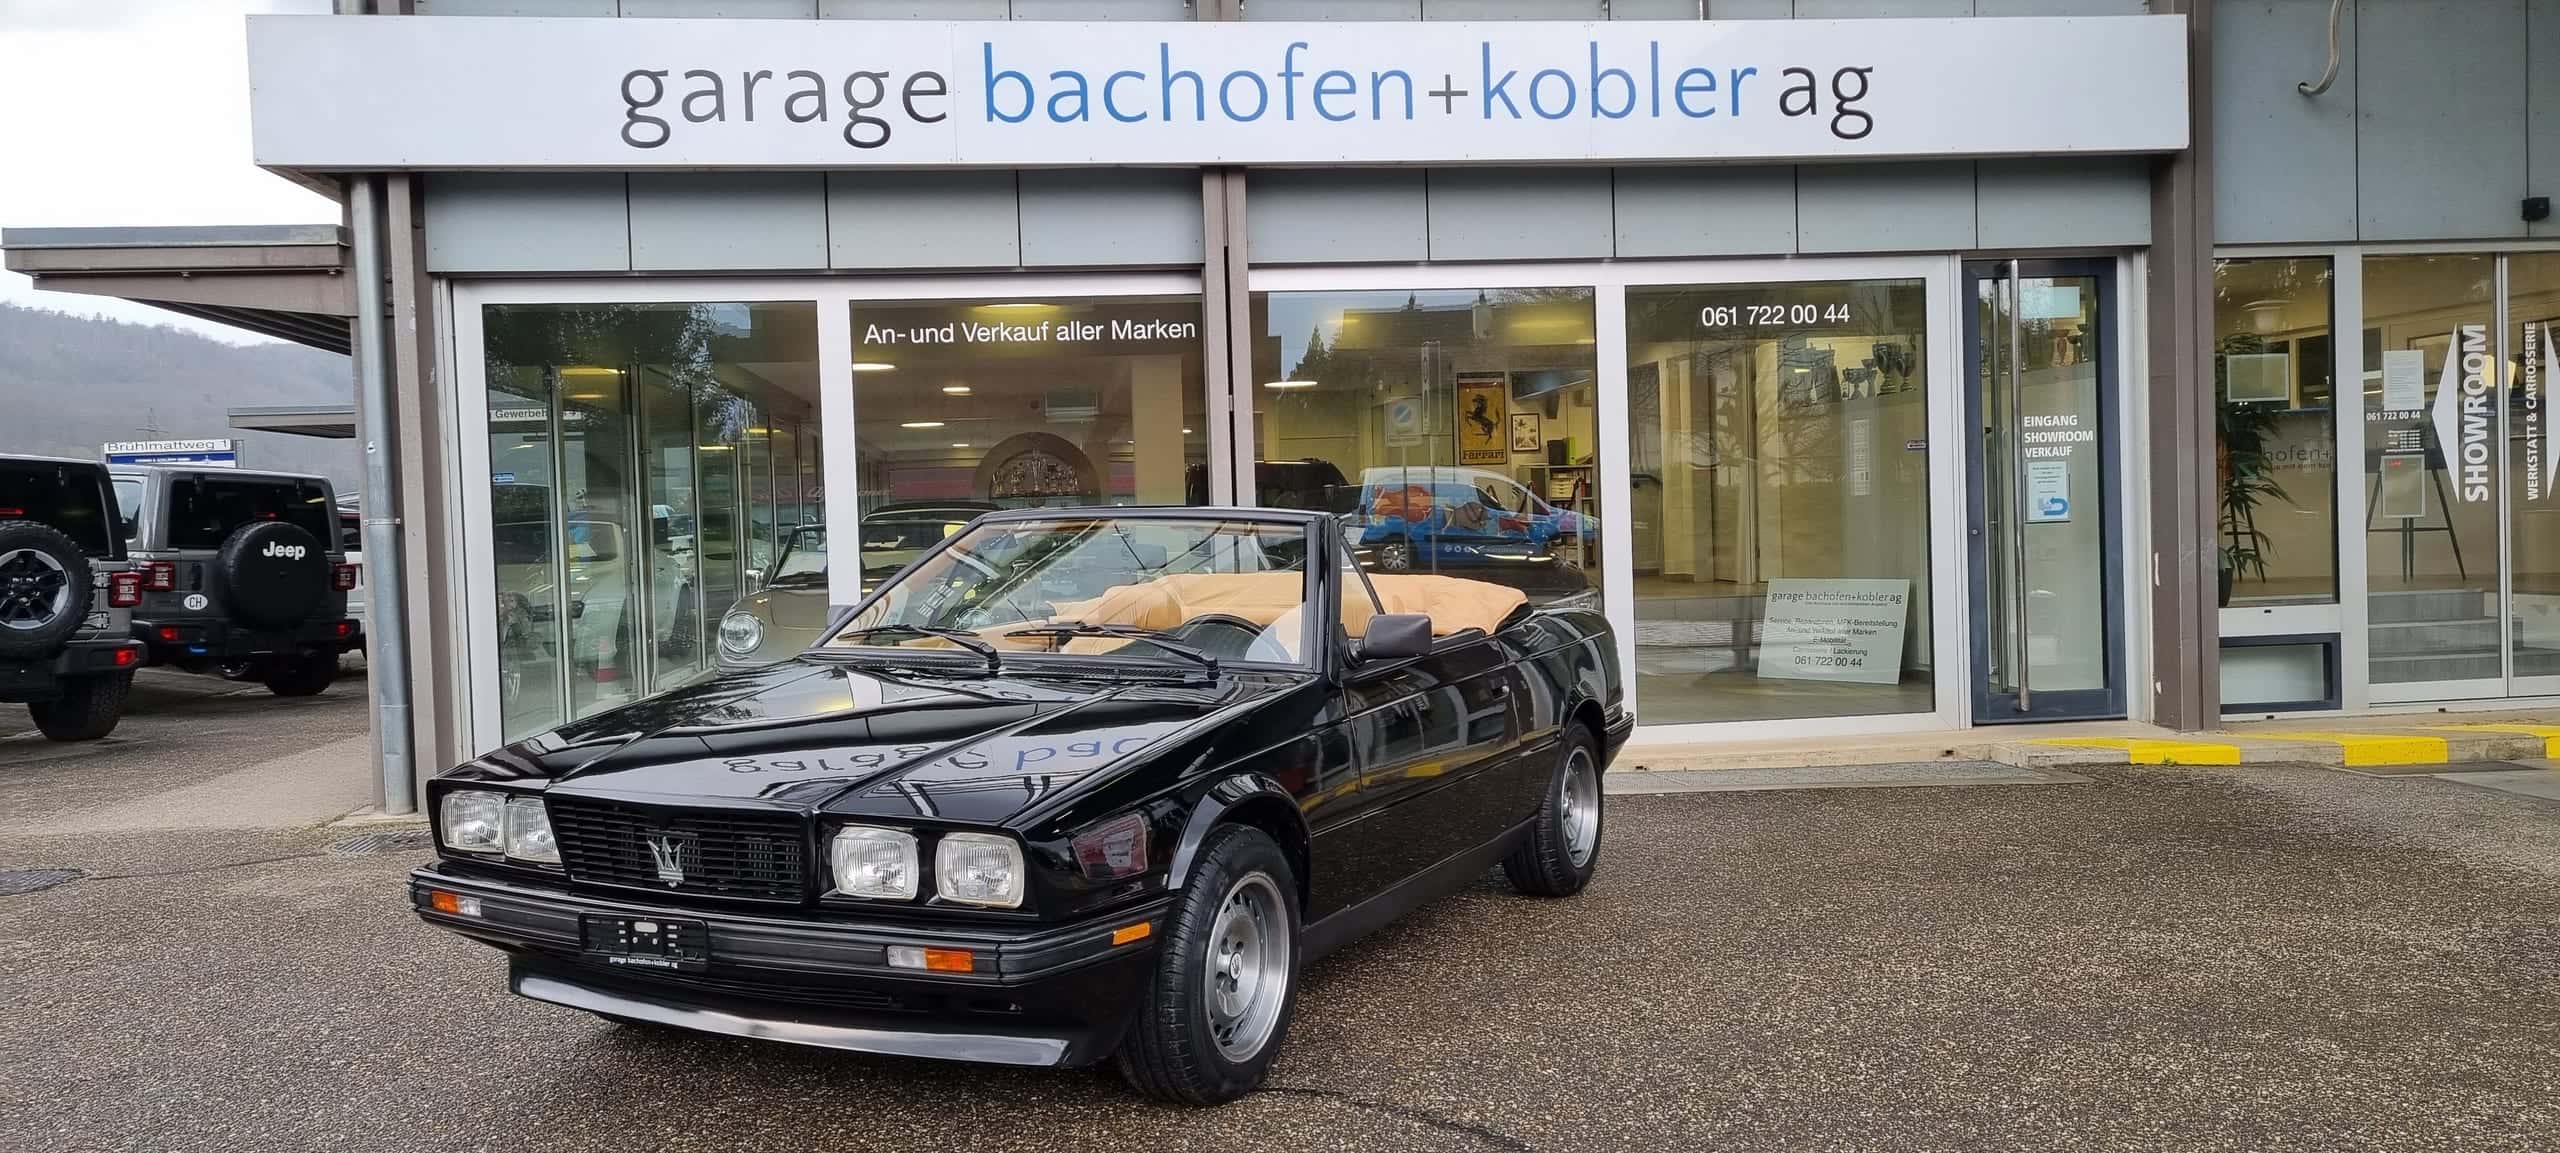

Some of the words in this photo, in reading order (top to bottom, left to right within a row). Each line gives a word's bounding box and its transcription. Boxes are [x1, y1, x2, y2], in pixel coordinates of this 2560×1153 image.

[620, 68, 948, 149] garage
[983, 40, 1758, 124] bachofen+kobler
[1778, 65, 1874, 141] ag
[1701, 306, 1738, 327] 061
[1746, 305, 1785, 325] 722
[1790, 304, 1817, 324] 00
[1823, 303, 1850, 323] 44
[864, 324, 906, 344] An-
[910, 323, 954, 343] und
[961, 321, 1050, 343] Verkauf
[1056, 320, 1104, 341] aller
[1111, 319, 1196, 340] Marken
[2524, 322, 2538, 410] CARROSSERIE
[2366, 411, 2380, 421] 061
[2383, 411, 2397, 420] 722
[2399, 411, 2409, 419] 00
[2411, 410, 2421, 419] 44
[2462, 324, 2489, 502] SHOWROOM
[2526, 411, 2538, 422] &
[2023, 415, 2078, 427] EINGANG
[2024, 430, 2094, 443] SHOWROOM
[2024, 446, 2073, 458] VERKAUF
[2526, 425, 2539, 501] WERKSTATT
[262, 541, 306, 561] Jeep
[189, 596, 202, 608] CH
[1771, 591, 1804, 603] garage
[1889, 594, 1902, 605] ag
[1794, 655, 1811, 665] 061
[1815, 656, 1833, 666] 722
[1835, 657, 1848, 667] 00
[1850, 657, 1863, 668] 44
